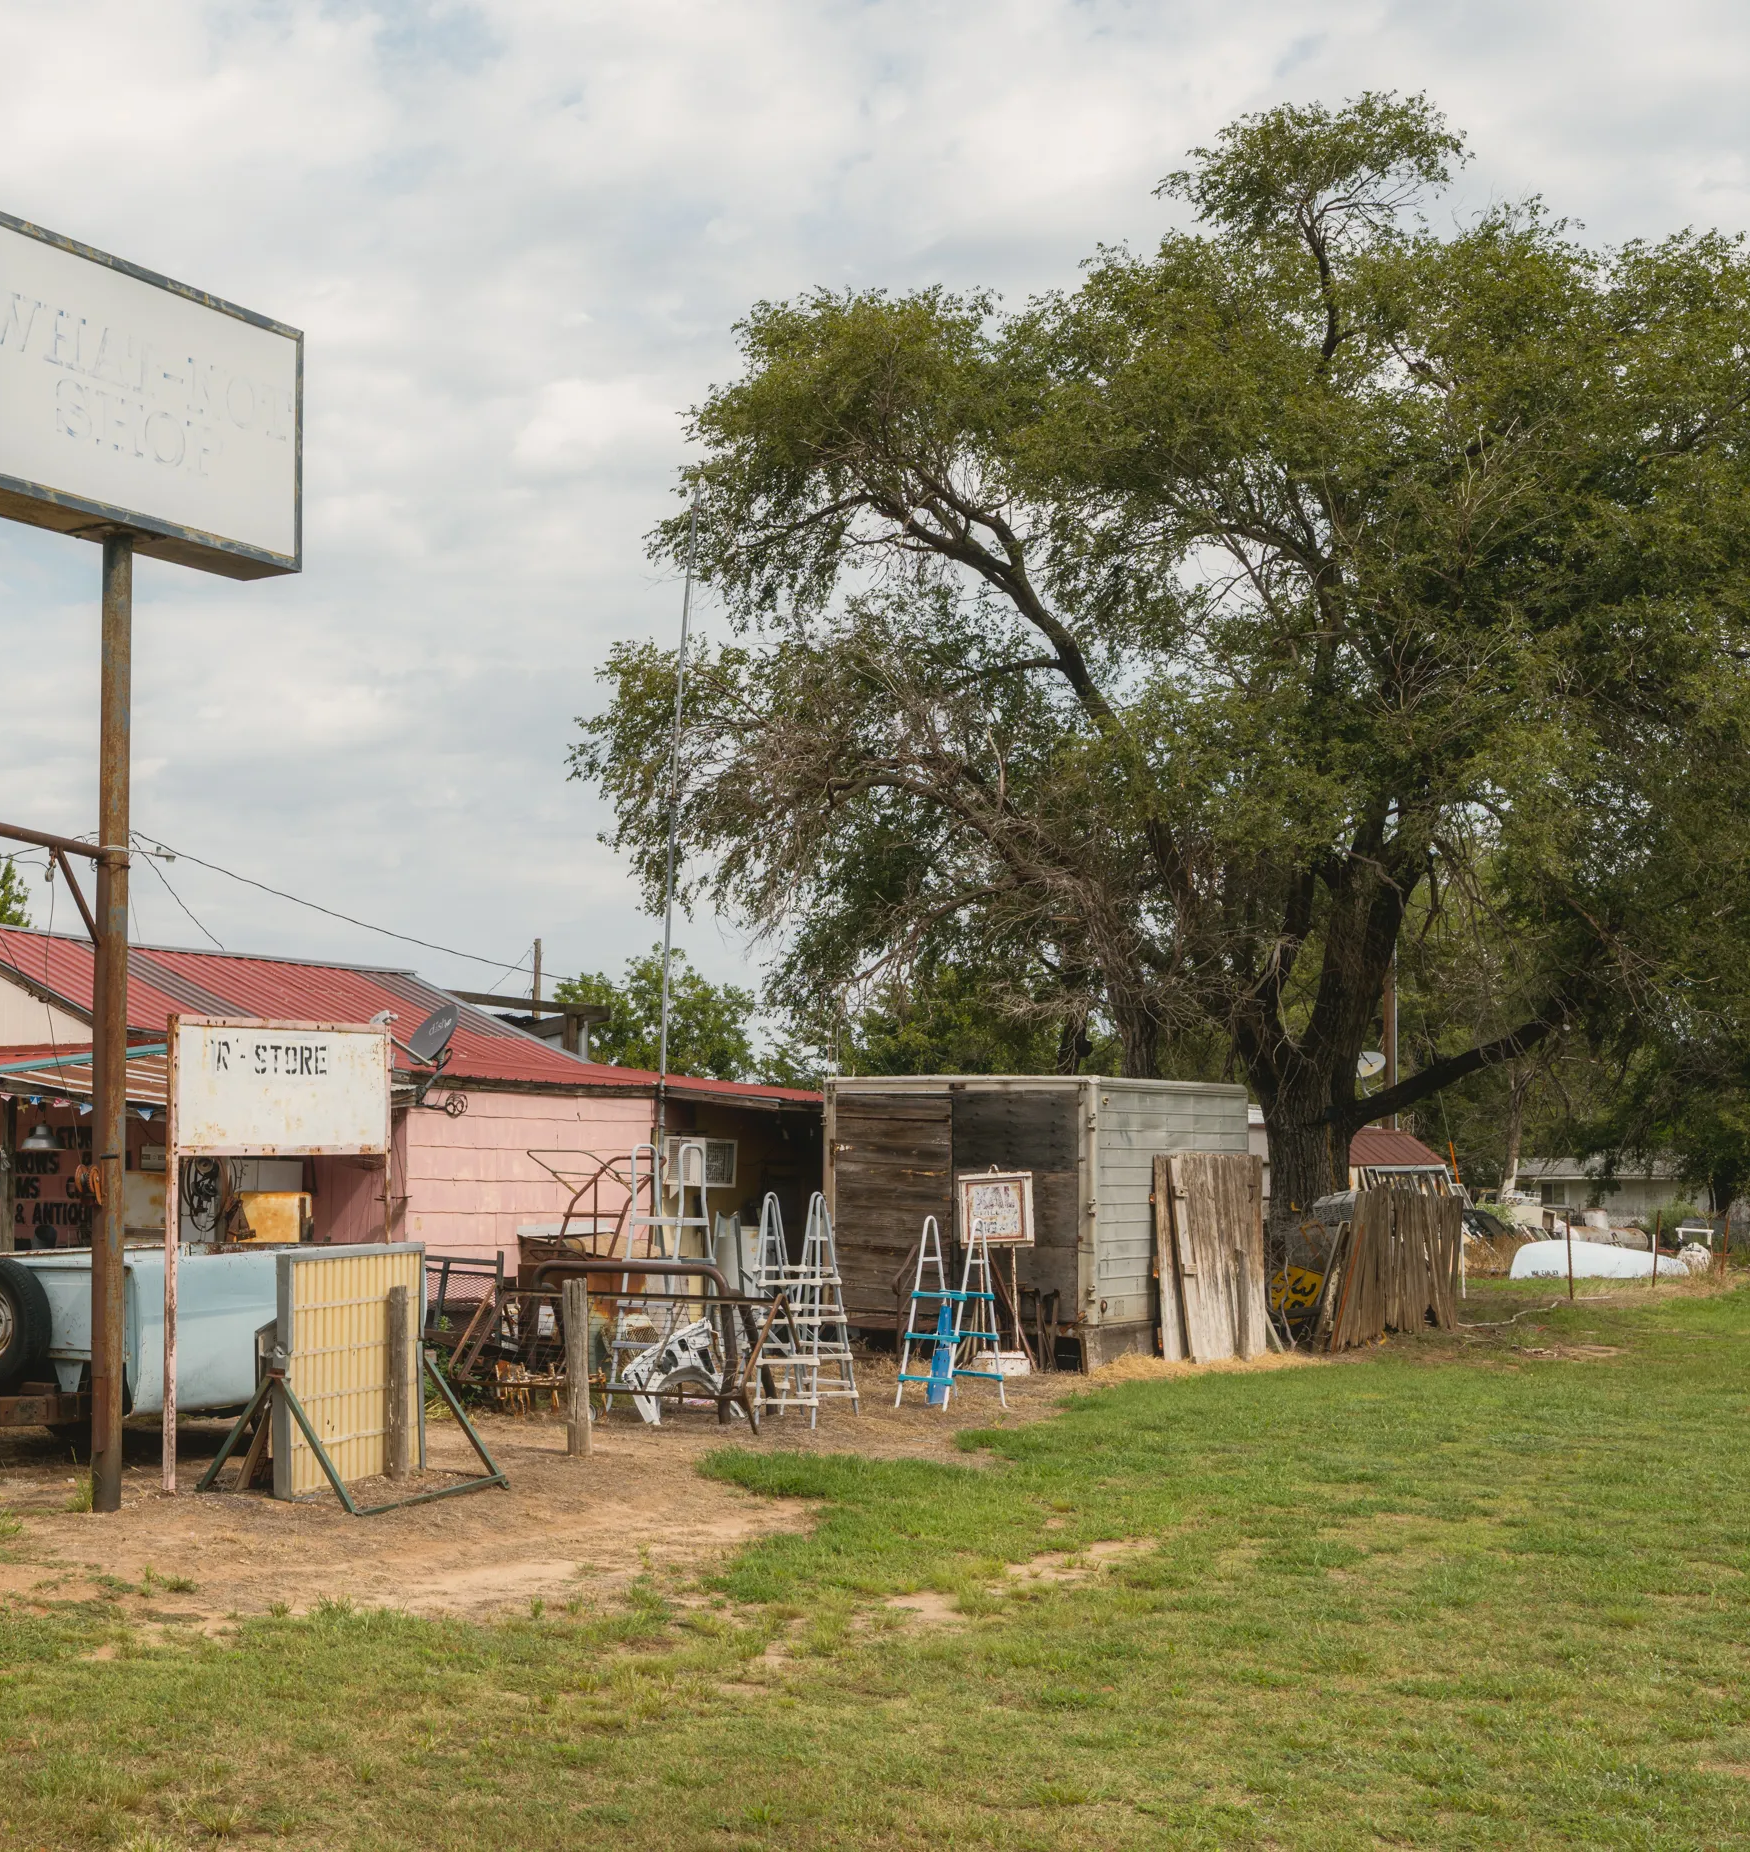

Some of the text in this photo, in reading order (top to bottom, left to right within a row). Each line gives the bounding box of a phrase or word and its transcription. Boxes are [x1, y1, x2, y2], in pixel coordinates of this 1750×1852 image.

[56, 378, 224, 477] SHOP
[254, 1044, 328, 1075] STORE
[15, 1203, 25, 1224] &
